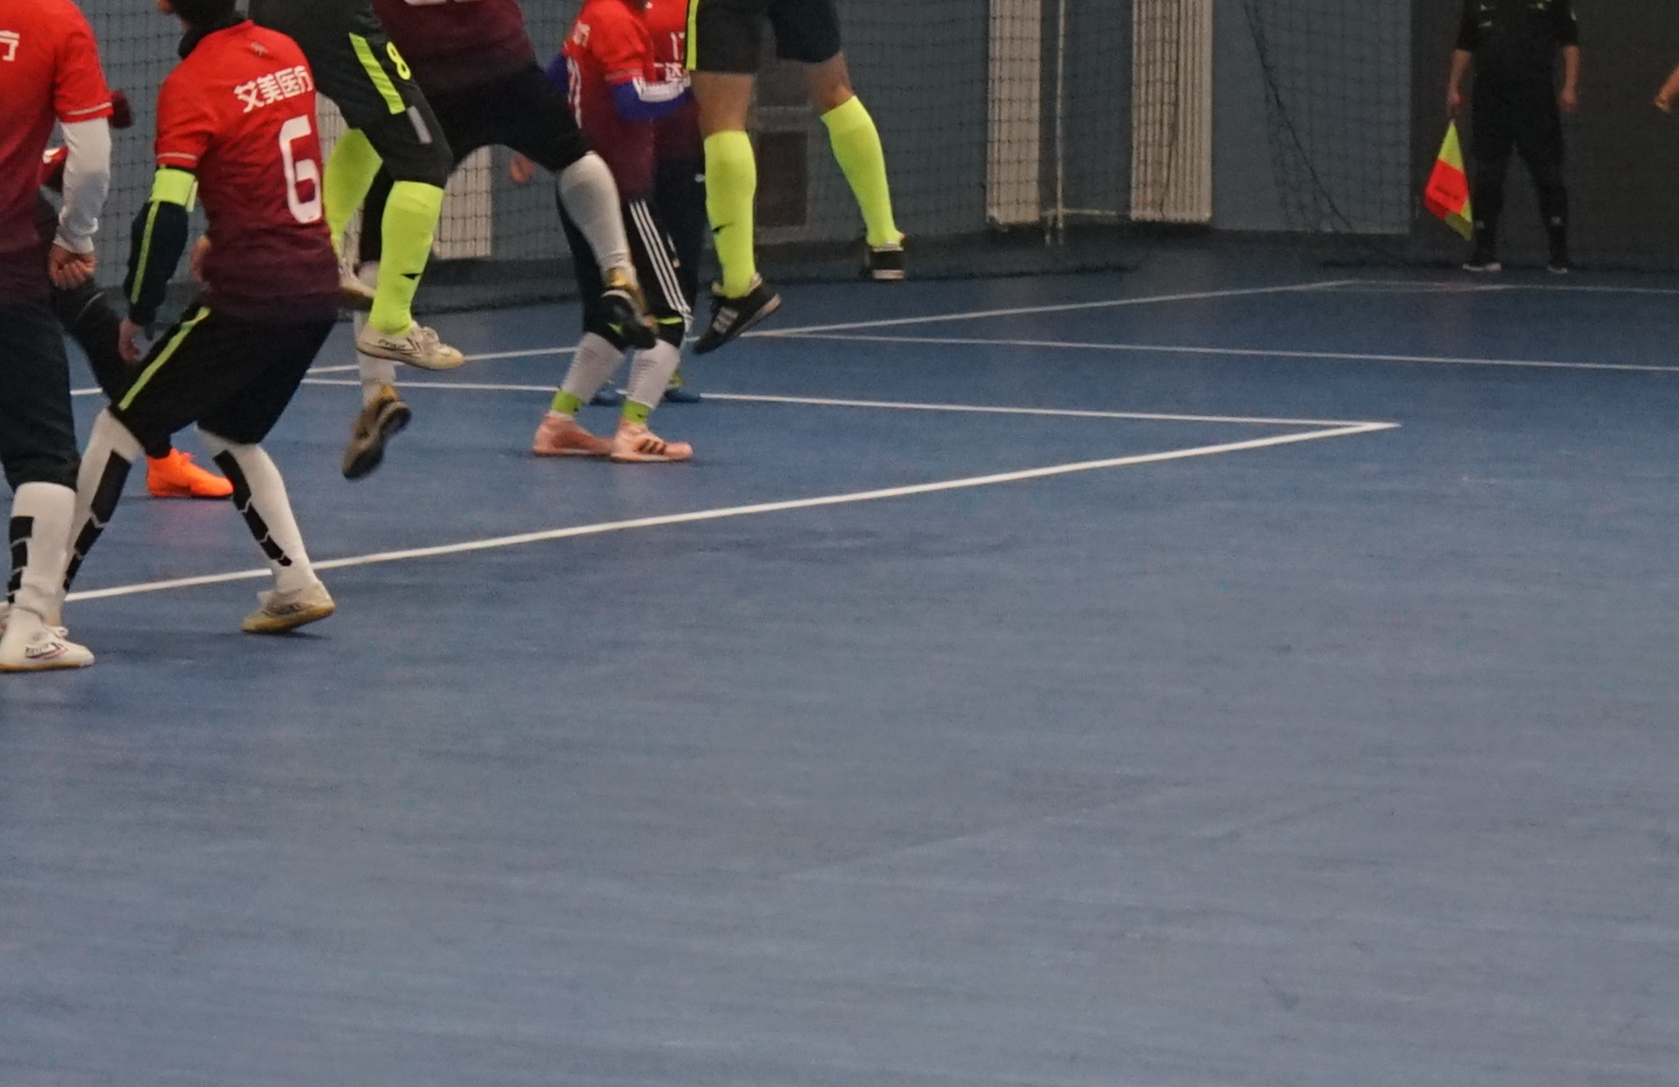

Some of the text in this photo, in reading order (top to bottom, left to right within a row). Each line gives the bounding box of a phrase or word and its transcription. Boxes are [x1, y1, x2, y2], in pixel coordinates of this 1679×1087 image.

[386, 41, 411, 80] 8
[233, 65, 314, 113] 艾美医疗
[279, 114, 322, 224] 6
